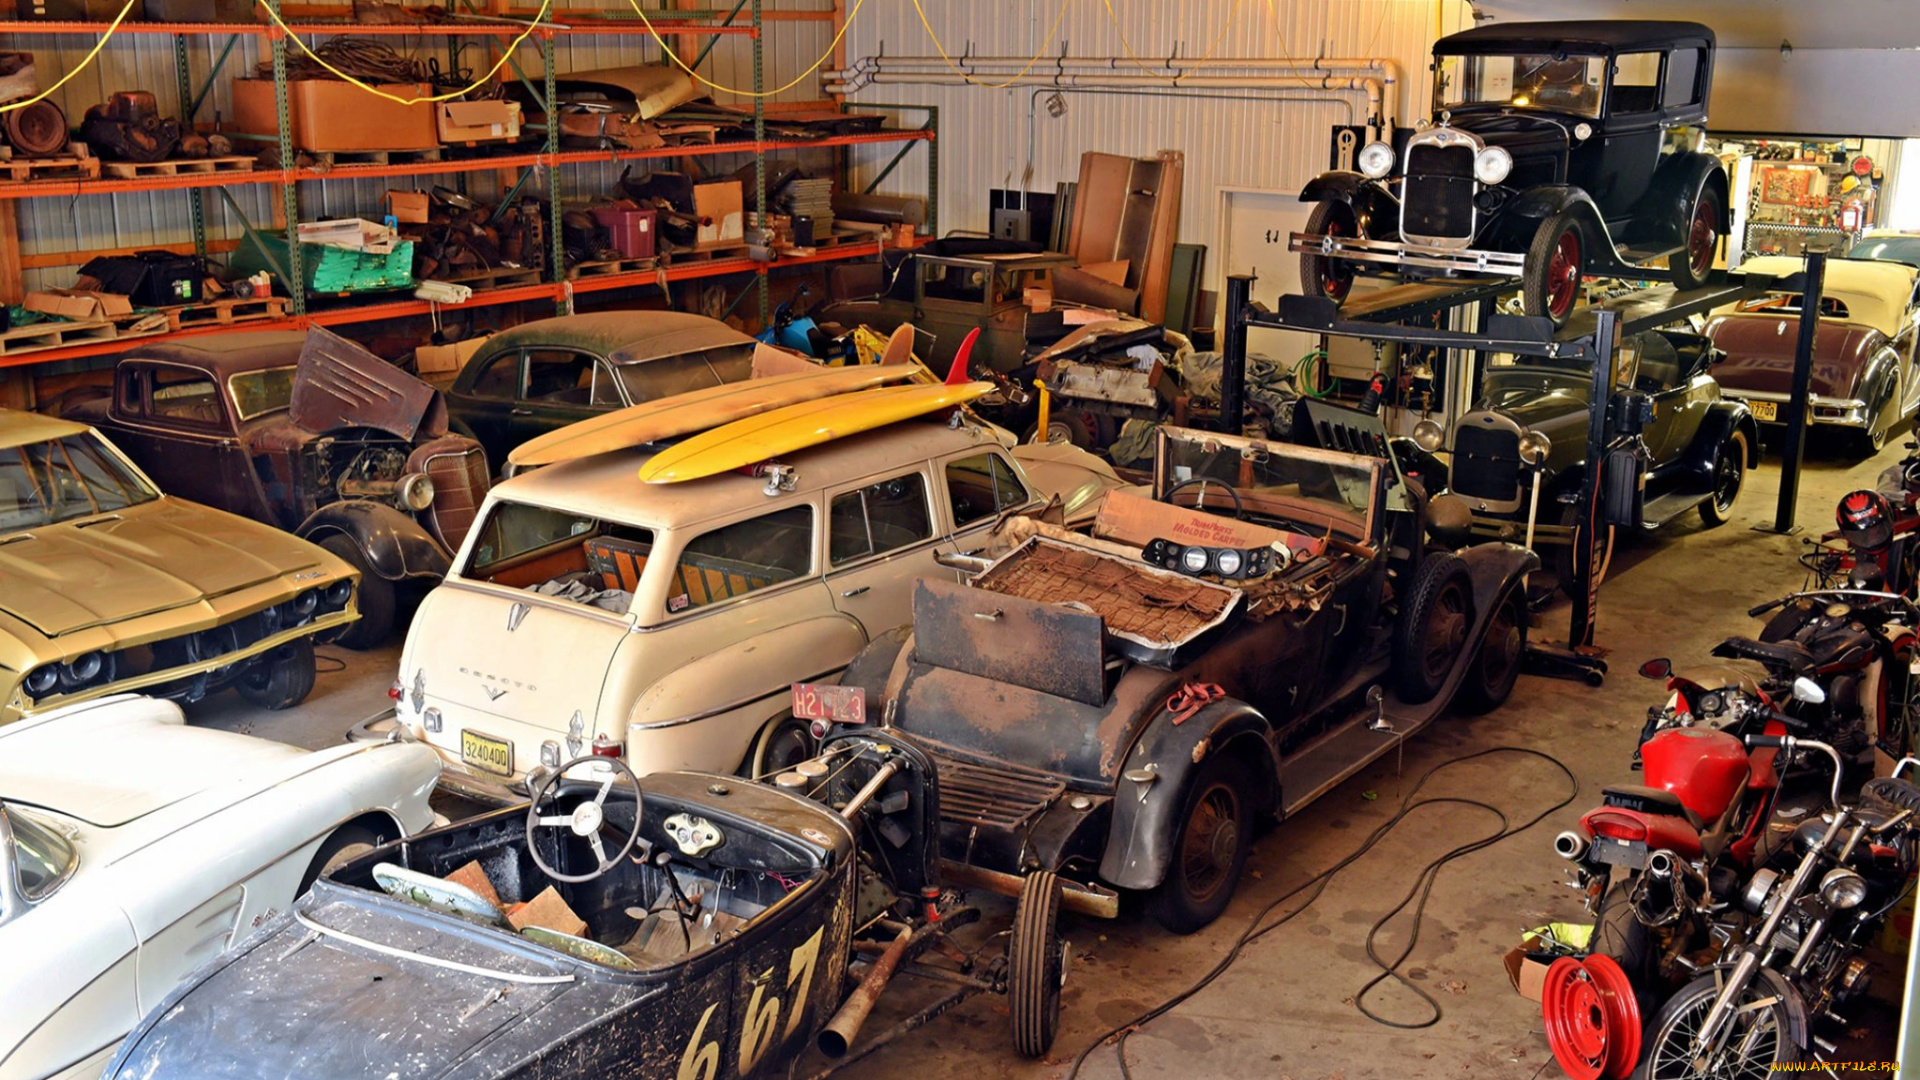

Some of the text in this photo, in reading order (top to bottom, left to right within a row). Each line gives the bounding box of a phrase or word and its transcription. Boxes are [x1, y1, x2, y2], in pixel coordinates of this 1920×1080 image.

[1173, 522, 1246, 547] MOLDED CARPET
[465, 740, 507, 767] 3240400
